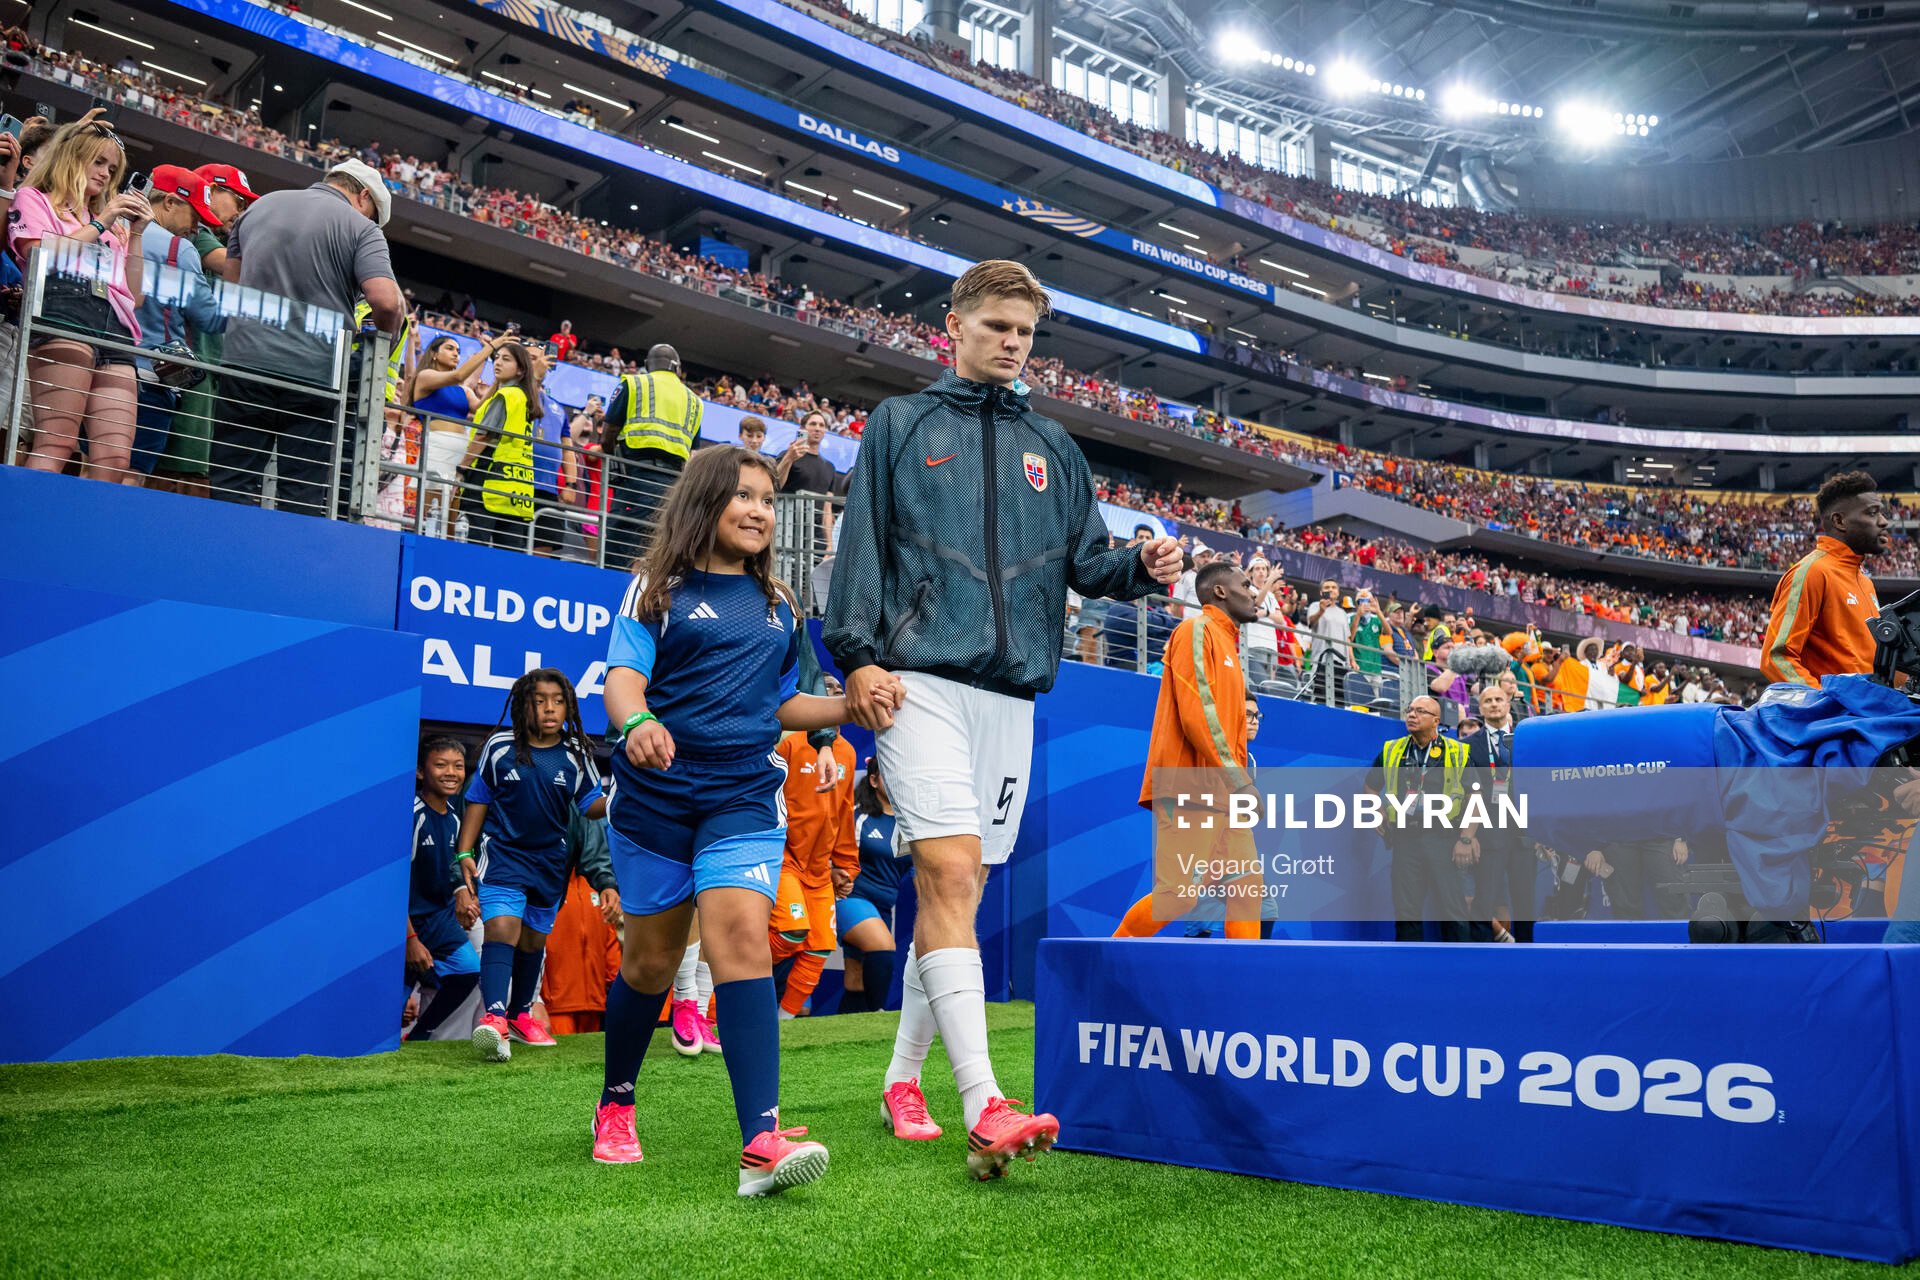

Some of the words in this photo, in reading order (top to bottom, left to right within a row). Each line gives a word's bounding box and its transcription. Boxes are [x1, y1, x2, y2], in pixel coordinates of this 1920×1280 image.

[798, 113, 900, 163] DALLAS
[1132, 238, 1160, 259] FIFA
[1160, 247, 1203, 273] WORLD
[1204, 264, 1228, 281] CUP
[1228, 272, 1268, 296] 2026
[410, 576, 526, 623] ORLD
[532, 596, 611, 635] CUP
[1551, 767, 1582, 781] FIFA
[1582, 763, 1635, 779] WORLD
[991, 776, 1018, 826] 5
[1078, 1021, 1173, 1072] FIFA
[1180, 1028, 1371, 1088] WORLD
[1382, 1041, 1506, 1100] CUP
[1517, 1050, 1777, 1124] 2026
